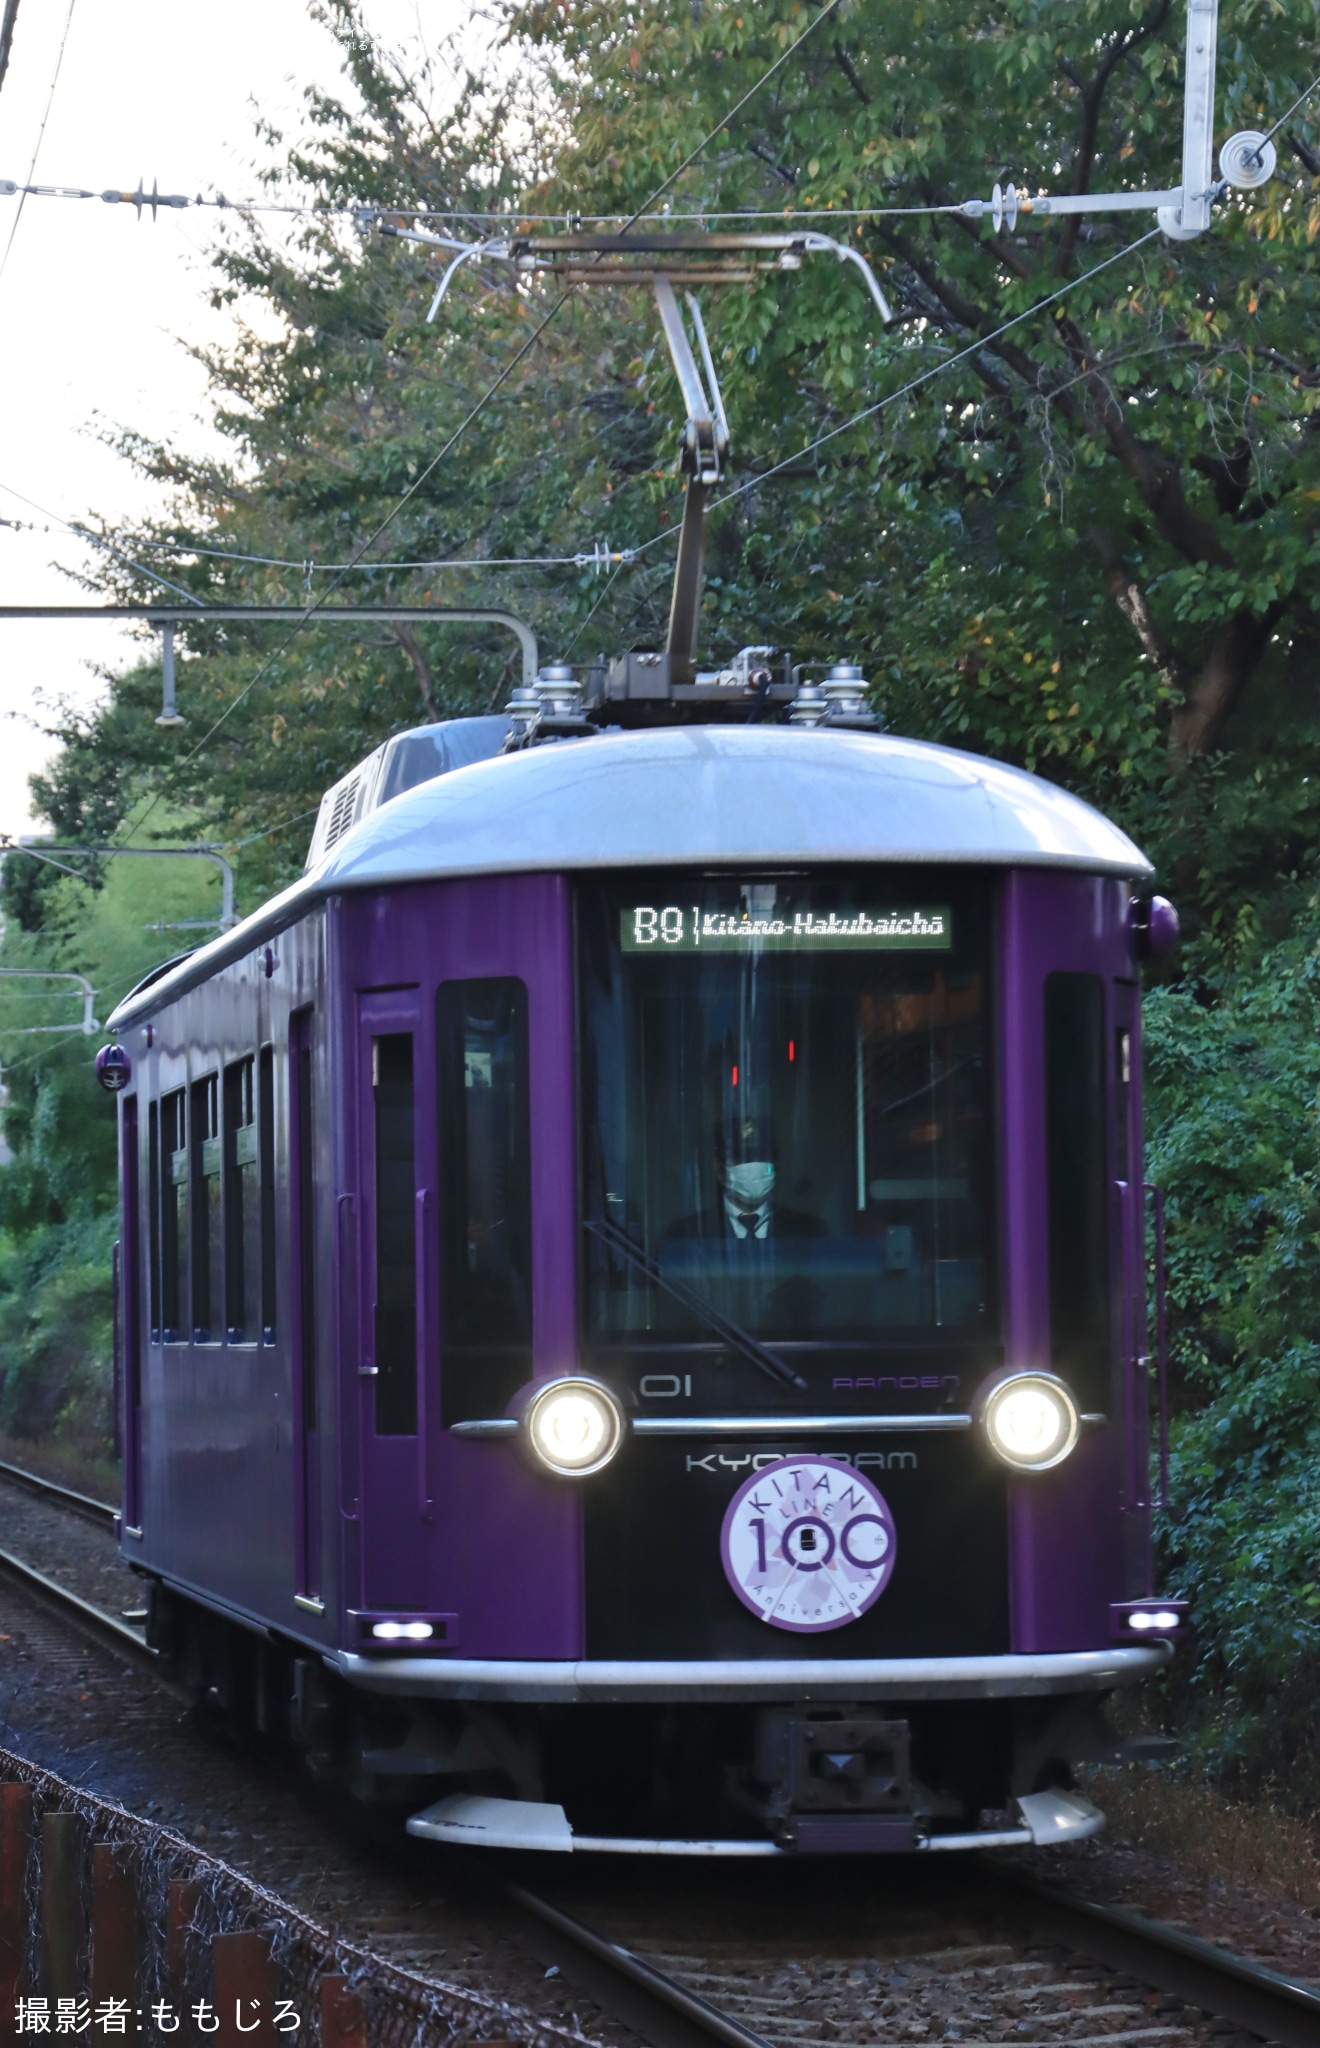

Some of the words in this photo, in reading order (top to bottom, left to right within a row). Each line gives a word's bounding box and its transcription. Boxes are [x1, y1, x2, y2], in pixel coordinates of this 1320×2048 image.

[634, 906, 684, 945] B9
[779, 1498, 834, 1518] LINE
[752, 1571, 877, 1616] Anniversary
